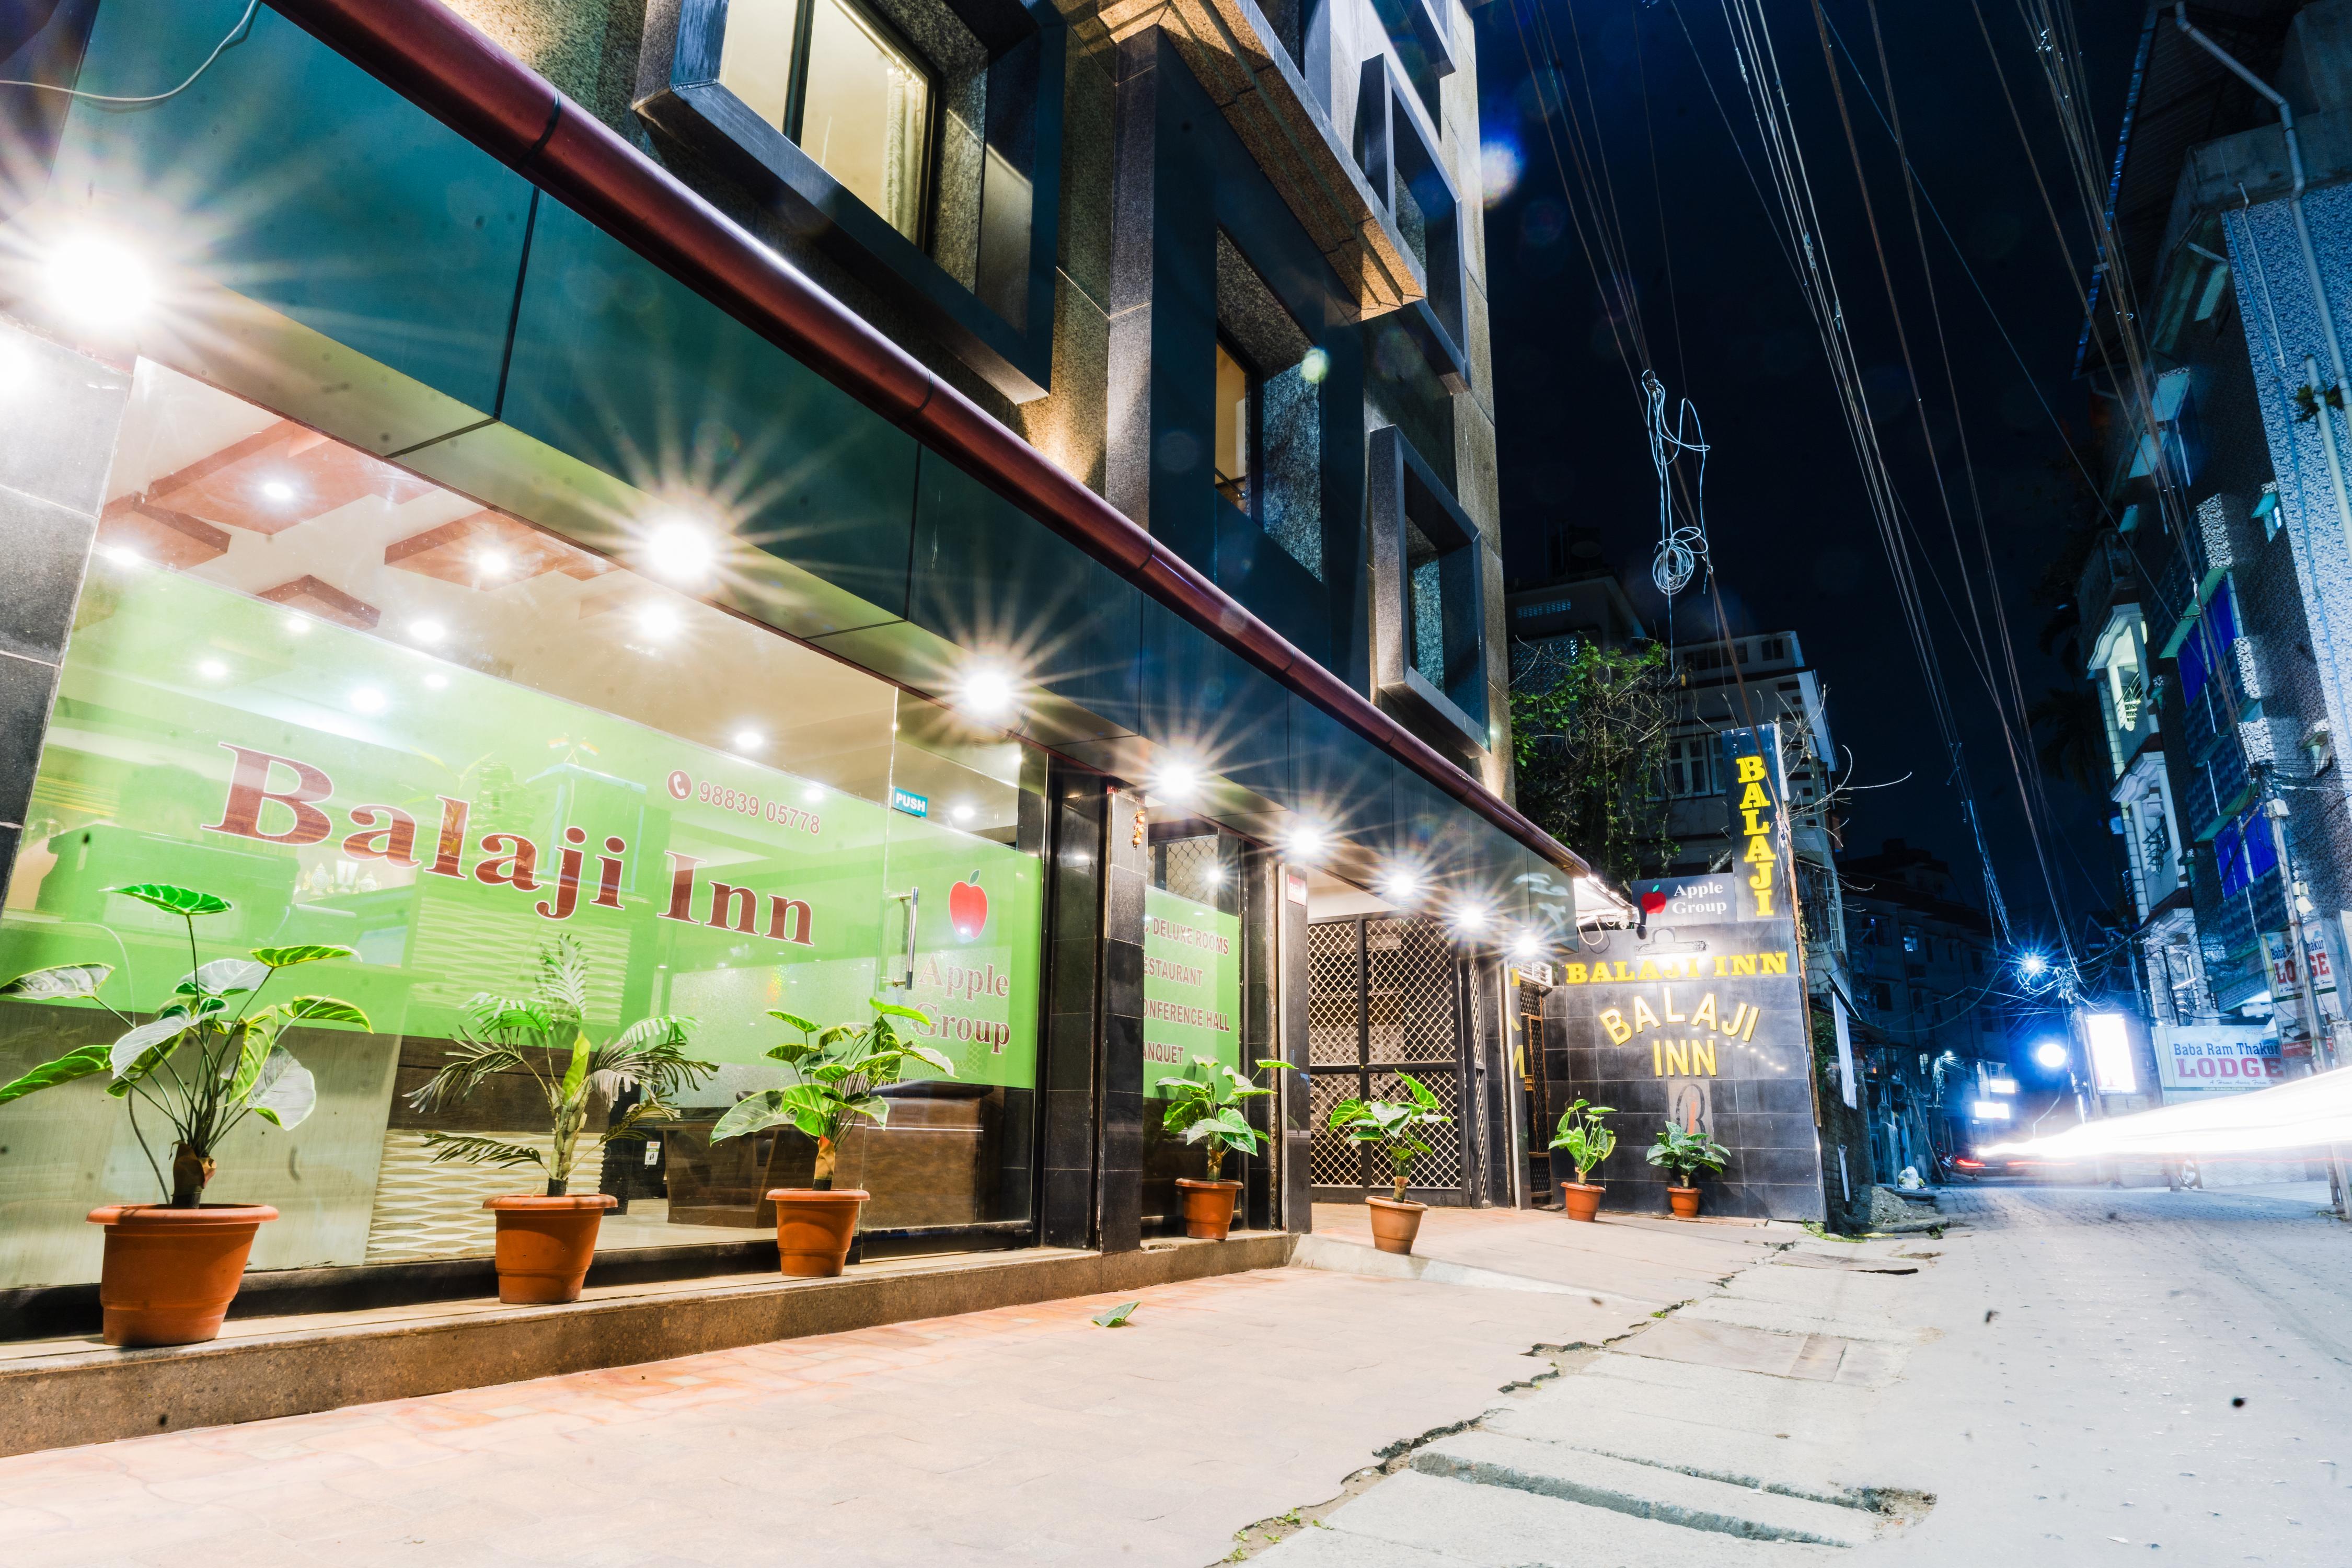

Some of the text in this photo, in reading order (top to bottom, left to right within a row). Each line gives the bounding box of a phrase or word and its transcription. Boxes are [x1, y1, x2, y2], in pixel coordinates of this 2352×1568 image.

[699, 781, 821, 835] 98839 05778
[895, 792, 926, 812] PUSH
[201, 742, 814, 946] Balaji Inn
[1736, 756, 1776, 916] BALAJI
[1674, 882, 1723, 898] Apple
[1672, 902, 1727, 915] Group
[1152, 917, 1229, 955] DELUXE ROOMS
[1566, 951, 1788, 984] BALAJI INN
[2270, 947, 2286, 960] Baba
[917, 953, 1009, 1001] Apple
[1144, 955, 1203, 987] ESTAURANT
[911, 1002, 1010, 1054] Group
[1143, 998, 1230, 1032] ONFERENCE HALL
[1599, 987, 1760, 1045] BALAJI
[1653, 1039, 1717, 1077] INN
[2173, 1043, 2203, 1055] Baba
[2206, 1043, 2233, 1055] Ram
[2236, 1042, 2279, 1055] Thakur
[2176, 1057, 2284, 1077] LODGE
